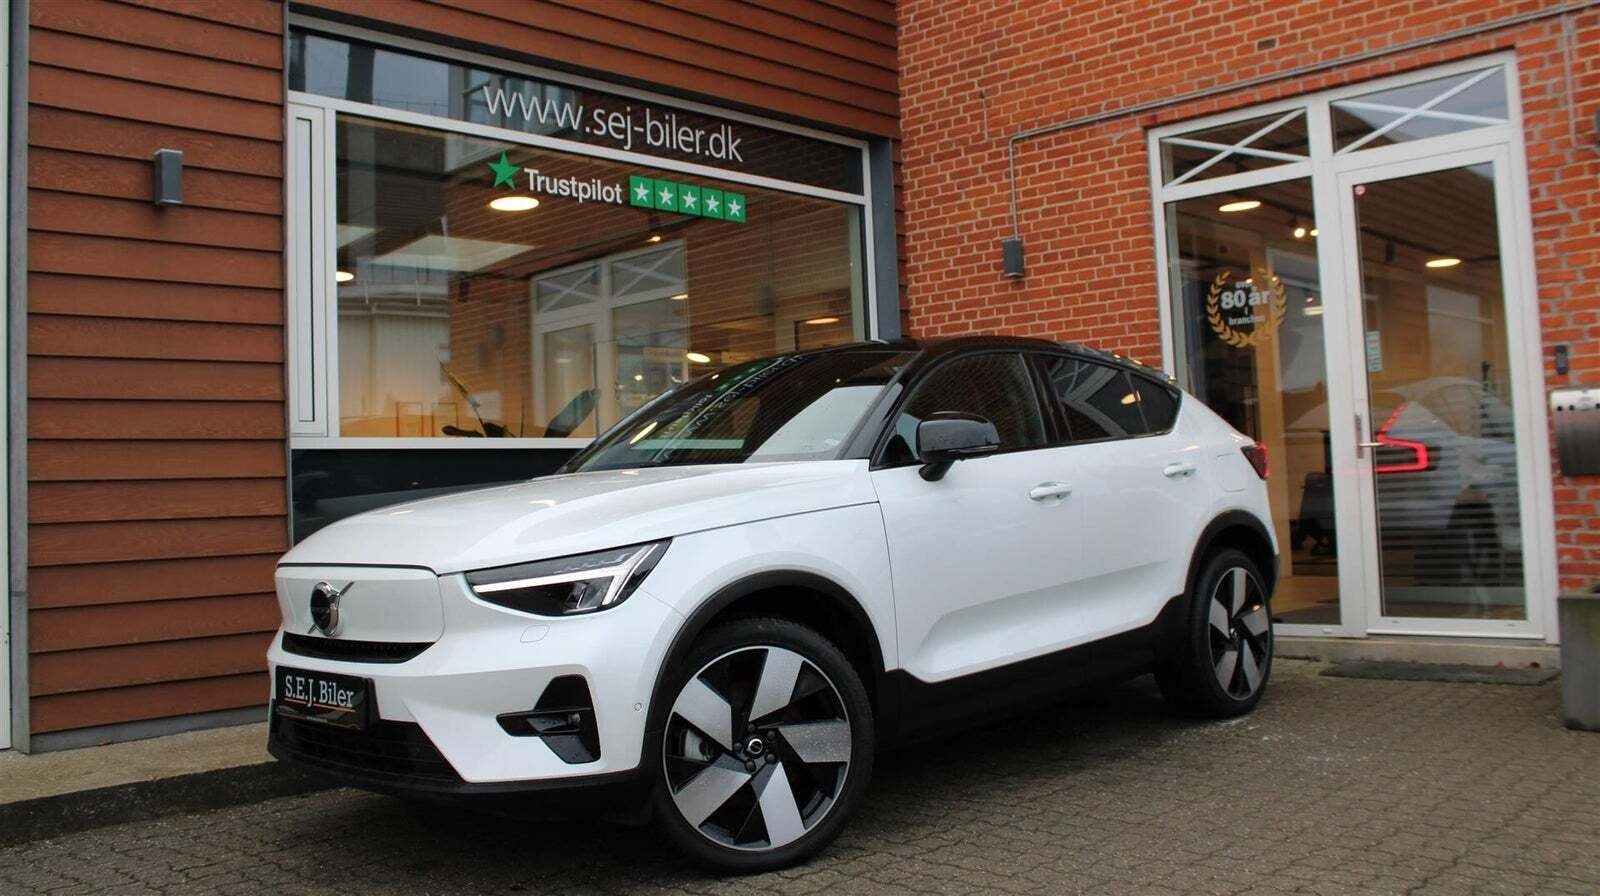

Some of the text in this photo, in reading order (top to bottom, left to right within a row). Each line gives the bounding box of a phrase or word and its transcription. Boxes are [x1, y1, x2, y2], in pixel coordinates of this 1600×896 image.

[483, 86, 743, 162] www.sej-biler.dk
[524, 168, 623, 204] Trustpilot
[1221, 290, 1246, 310] 80
[285, 675, 354, 708] S.E.J. Biler
